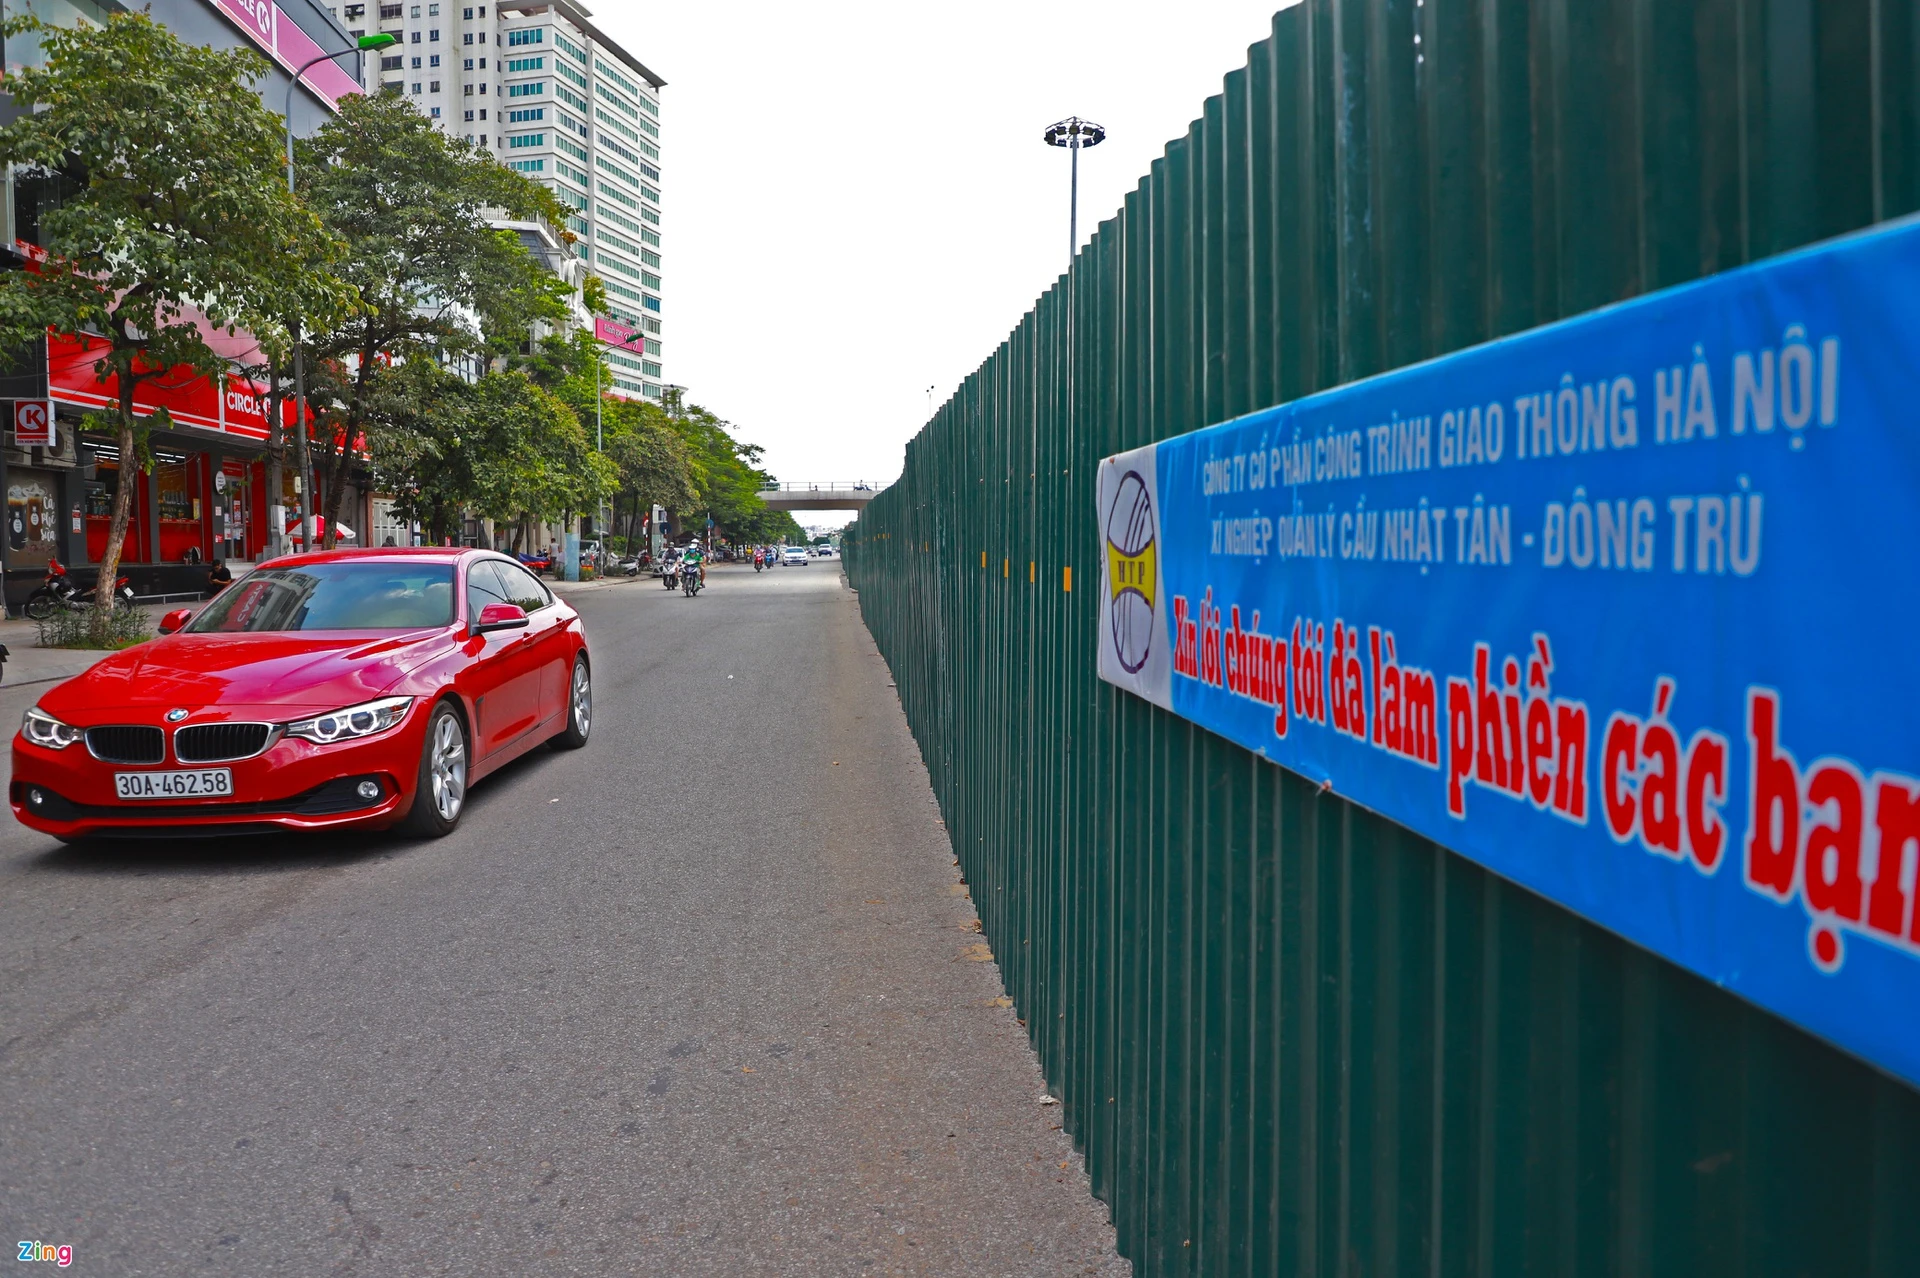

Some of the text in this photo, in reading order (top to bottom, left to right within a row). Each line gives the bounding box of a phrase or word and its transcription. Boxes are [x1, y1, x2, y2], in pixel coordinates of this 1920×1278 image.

[227, 391, 261, 416] CIRCLE
[1204, 453, 1231, 496] CÔNG
[1233, 454, 1246, 492] TY
[1250, 430, 1268, 490] CỔ
[1315, 425, 1362, 482] CÔNG
[1367, 409, 1431, 476] TRÌNH
[1439, 401, 1504, 468] GIAO
[1514, 374, 1638, 459] THÔNG
[1654, 343, 1717, 445] HÀ
[1731, 323, 1840, 451] NỘI
[22, 406, 45, 430] K
[1210, 511, 1223, 554] XÍ
[1224, 508, 1272, 566] NGHIỆP
[1278, 500, 1316, 560] QUẢN
[1318, 503, 1335, 558] LÝ
[1340, 494, 1377, 560] CẦU
[1383, 496, 1446, 576] NHẬT
[1454, 493, 1512, 566] TÂN
[1542, 485, 1655, 571] ĐÔNG
[1117, 560, 1145, 584] HTP
[1174, 595, 1198, 679] Xin
[1225, 604, 1288, 739] chúng
[1291, 615, 1326, 724] tôi
[1328, 618, 1366, 740] đã
[1369, 625, 1440, 768] làm
[1446, 633, 1588, 823] phiền
[1601, 675, 1729, 876] các
[118, 772, 228, 796] 30A-462.58
